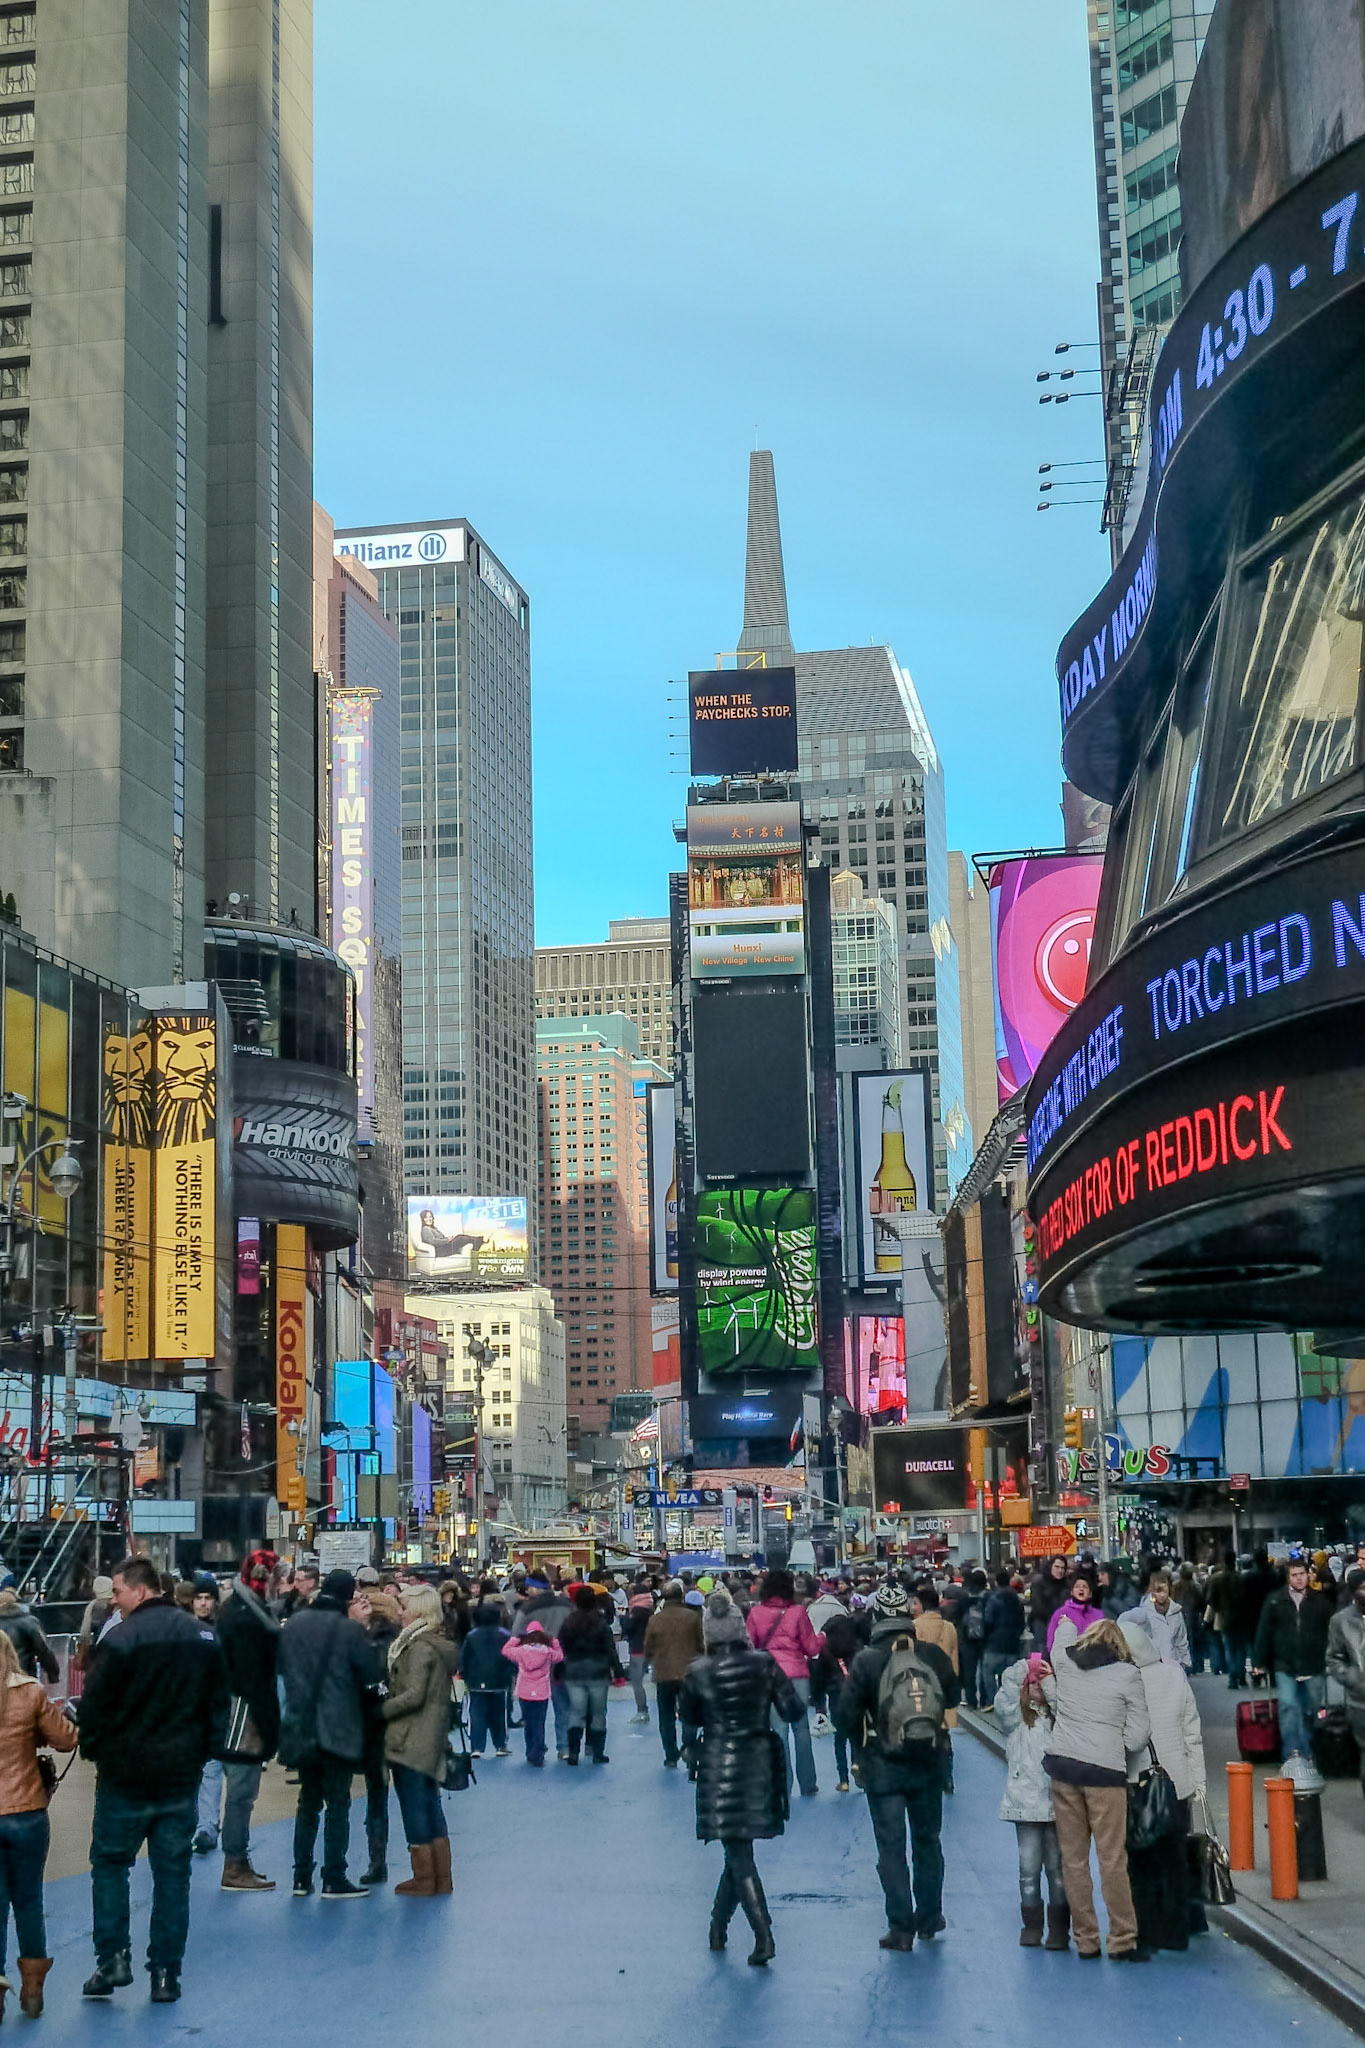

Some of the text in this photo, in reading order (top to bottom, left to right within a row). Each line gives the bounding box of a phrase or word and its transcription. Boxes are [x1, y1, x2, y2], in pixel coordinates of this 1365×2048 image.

[1154, 367, 1182, 468] OM
[1196, 263, 1274, 390] 4:30
[1320, 191, 1365, 276] 7
[339, 543, 412, 562] Allianz
[695, 694, 752, 707] WHEN THE
[695, 706, 792, 720] PAYCHECKS STOP,
[337, 735, 366, 887] TIMES
[731, 825, 784, 838] 天下名村
[733, 943, 762, 953] Huaxi
[702, 957, 720, 965] New
[722, 956, 748, 966] Village
[773, 955, 794, 963] China
[1146, 912, 1312, 1040] TORCHED
[1062, 1045, 1088, 1118] WITH
[1087, 1003, 1124, 1090] GRIEF
[268, 1147, 313, 1165] driving
[1048, 1197, 1064, 1252] RED
[1064, 1176, 1085, 1239] SOX
[1085, 1156, 1113, 1224] FOR
[1116, 1139, 1140, 1205] OF
[1145, 1085, 1293, 1192] REDDICK
[175, 1160, 188, 1238] NOTHING
[190, 1215, 202, 1229] IS
[175, 1244, 188, 1277] ELSE
[190, 1235, 202, 1292] SIMPLY
[501, 1265, 524, 1274] OWN
[697, 1267, 767, 1279] display powered
[713, 1279, 734, 1287] wind
[735, 1279, 765, 1288] energy
[175, 1284, 188, 1316] LIKE
[279, 1300, 303, 1430] Kodak
[735, 1412, 758, 1420] Hyai
[905, 1460, 954, 1473] DURACELL
[656, 1493, 699, 1505] NIVEA
[916, 1518, 944, 1531] swatch
